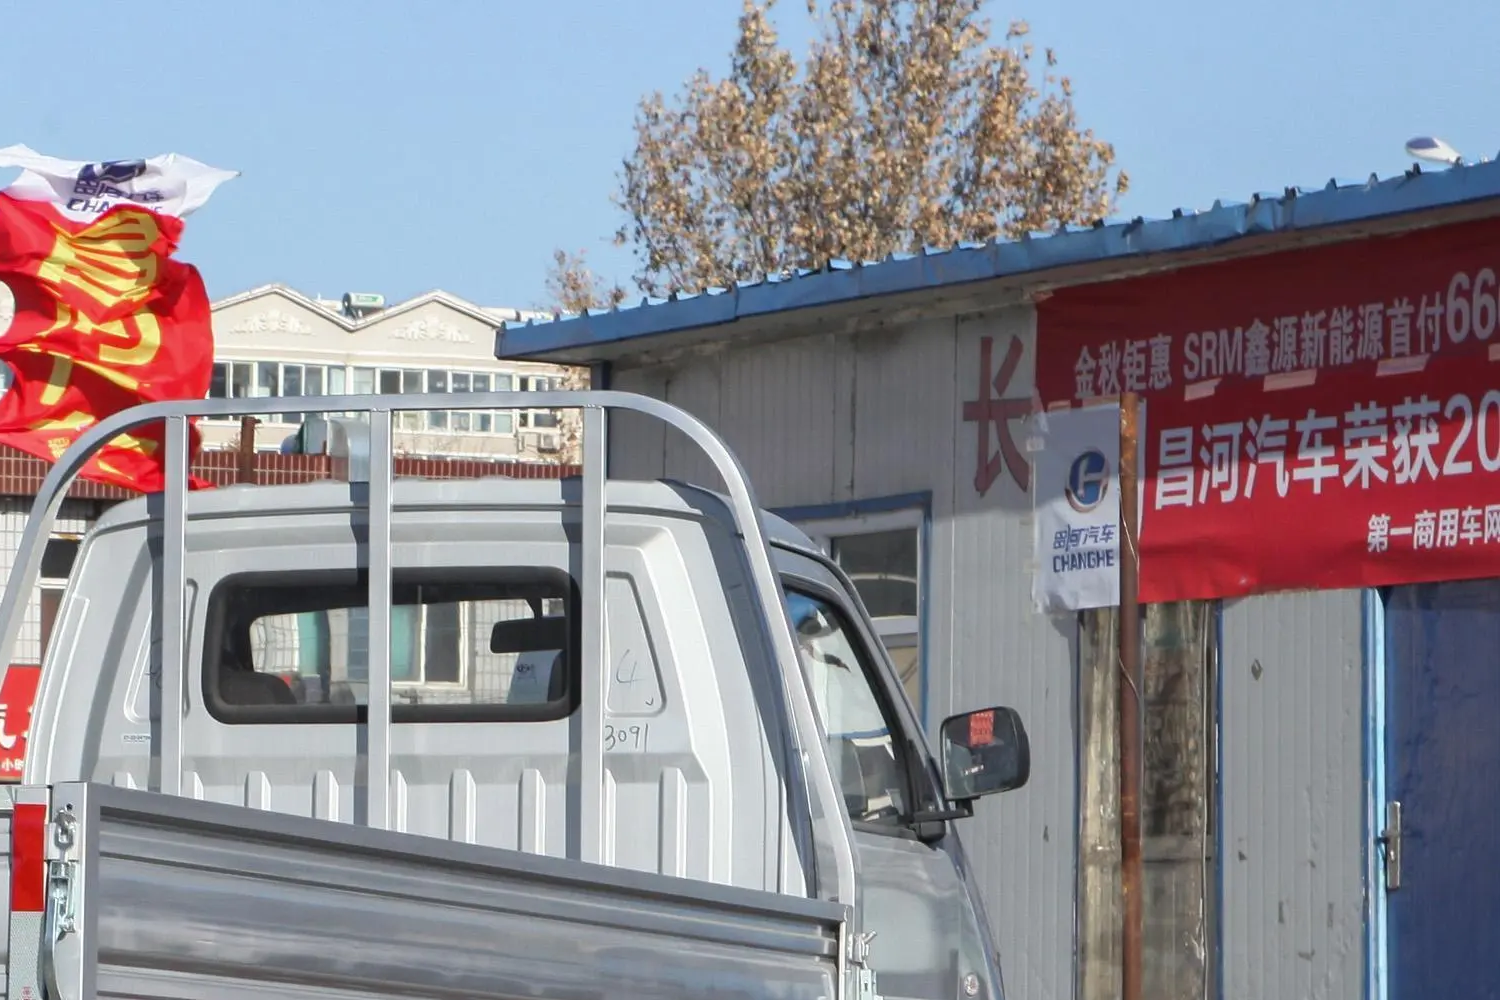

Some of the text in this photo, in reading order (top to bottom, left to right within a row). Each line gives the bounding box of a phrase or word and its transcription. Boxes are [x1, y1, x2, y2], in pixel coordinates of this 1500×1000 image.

[1074, 267, 1500, 398] 金秋钜惠 SRM鑫源新能源首付66
[963, 334, 1033, 498] 长
[1053, 523, 1116, 551] 昌河汽车
[1053, 549, 1114, 573] CHANGHE
